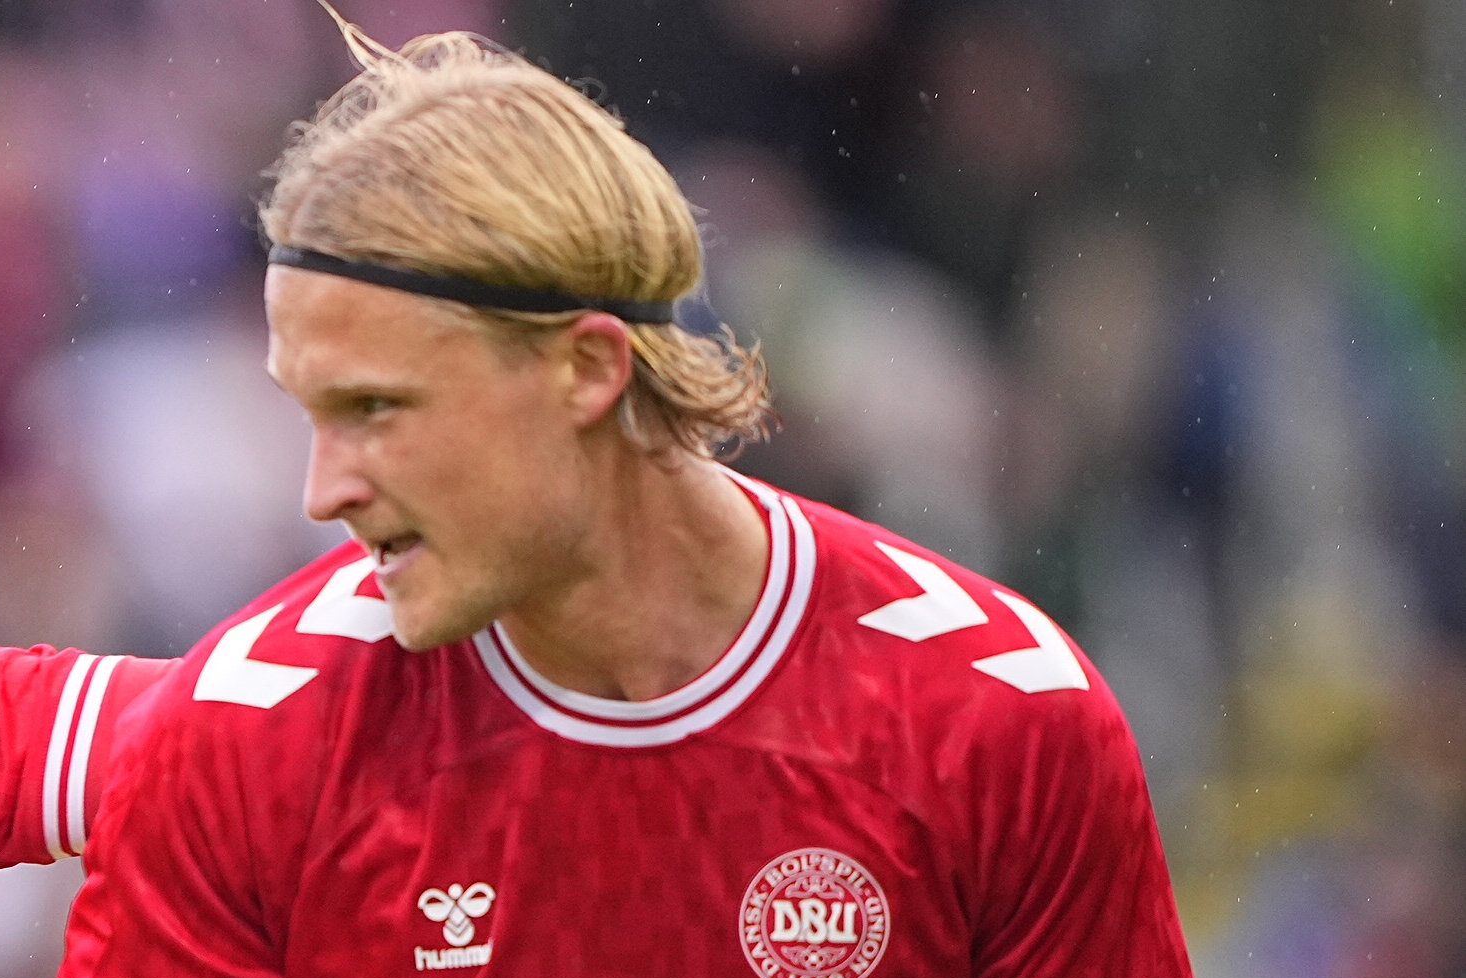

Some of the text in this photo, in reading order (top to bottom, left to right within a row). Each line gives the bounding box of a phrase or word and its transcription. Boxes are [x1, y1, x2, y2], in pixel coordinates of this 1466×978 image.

[745, 890, 781, 977] DANSK
[770, 898, 858, 944] DBU
[850, 897, 885, 975] UNION
